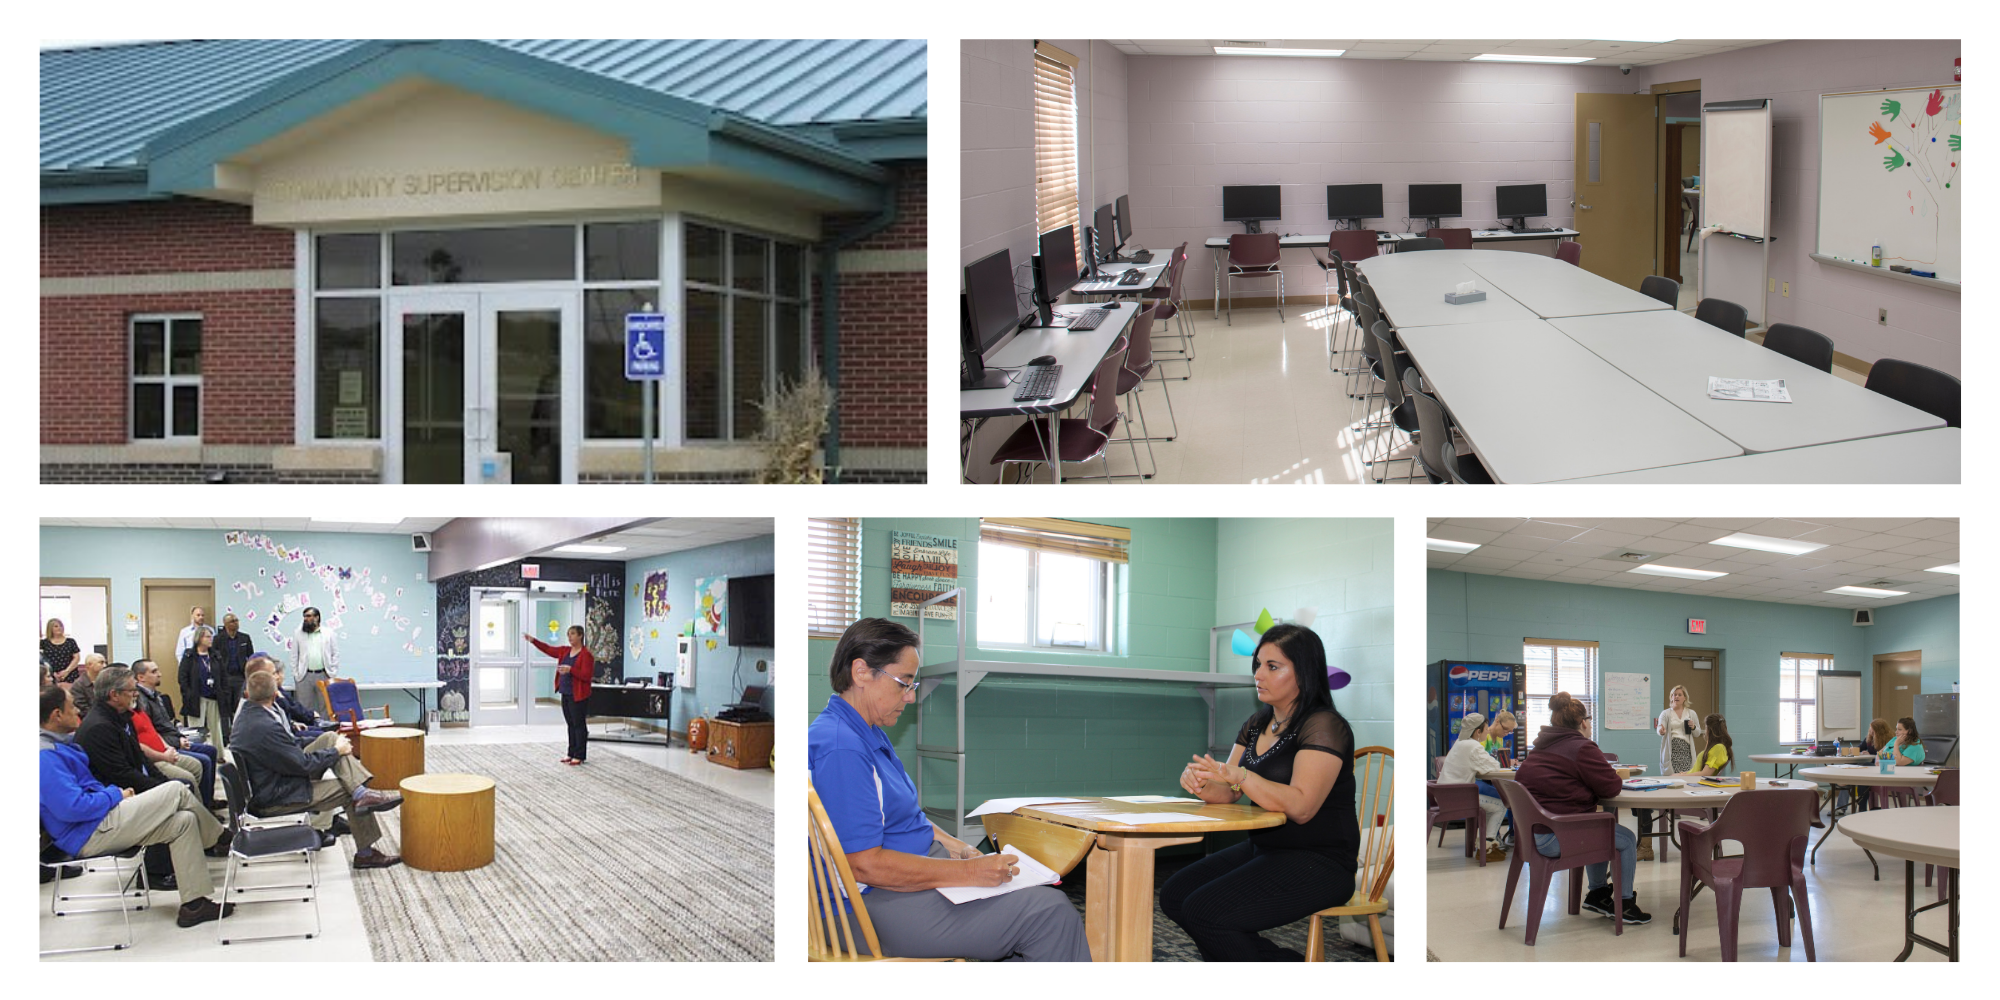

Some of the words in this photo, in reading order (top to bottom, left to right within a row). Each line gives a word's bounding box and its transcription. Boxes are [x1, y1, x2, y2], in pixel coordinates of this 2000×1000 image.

[403, 166, 541, 196] SUPERVISION
[553, 163, 639, 189] CENTER
[902, 539, 932, 548] FRIENDS
[932, 537, 957, 548] SMILE
[903, 546, 911, 563] LOVE
[913, 554, 950, 565] FAMILY
[893, 560, 923, 573] Laugh
[934, 564, 951, 572] JOY
[893, 571, 901, 579] BE
[903, 572, 922, 581] HAPPY
[934, 582, 955, 592] FAITH
[893, 590, 955, 604] ENCOURGE
[1691, 619, 1705, 633] EXIT
[1467, 670, 1511, 682] PEPSI
